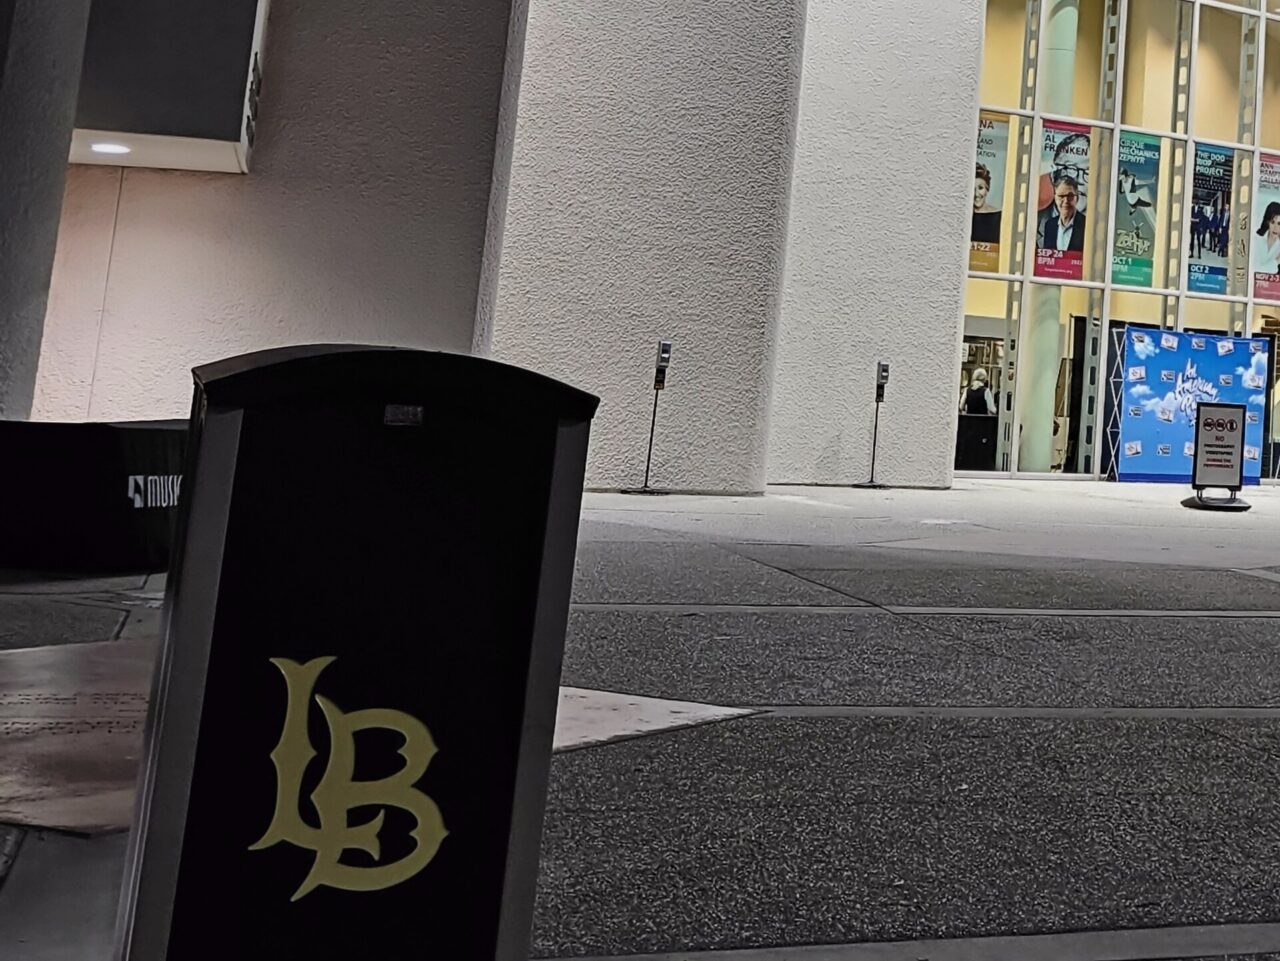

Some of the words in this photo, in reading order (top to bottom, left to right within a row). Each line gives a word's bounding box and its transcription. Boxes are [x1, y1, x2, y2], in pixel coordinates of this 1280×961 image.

[1044, 144, 1089, 156] FRANKEN
[1195, 165, 1224, 177] PROJECT
[1037, 248, 1053, 257] SEP
[1190, 265, 1204, 273] OCT
